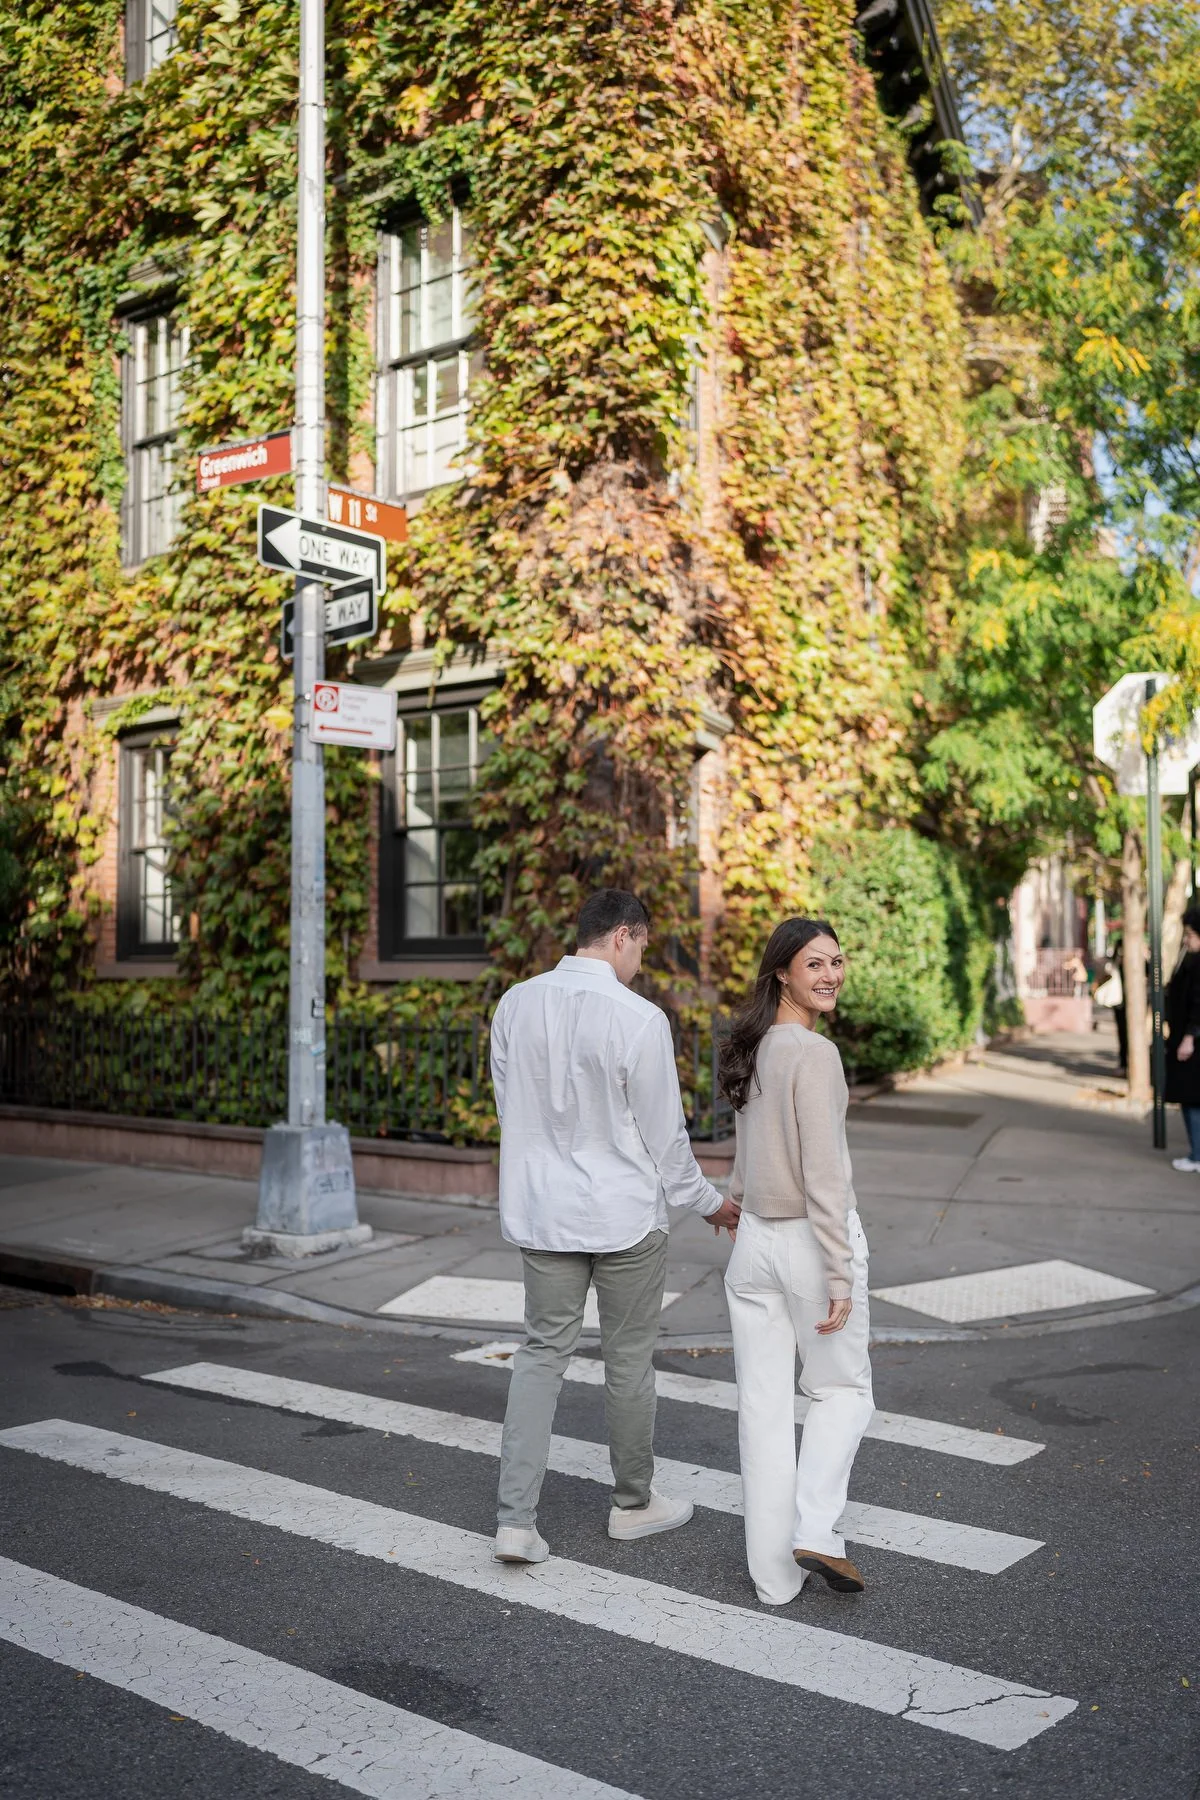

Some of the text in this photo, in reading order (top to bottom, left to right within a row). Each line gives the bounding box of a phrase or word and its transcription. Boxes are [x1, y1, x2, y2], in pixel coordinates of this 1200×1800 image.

[200, 444, 268, 478] Greenwich
[328, 493, 378, 527] W 11 St
[300, 535, 370, 572] ONE WAY
[338, 598, 365, 621] WAY
